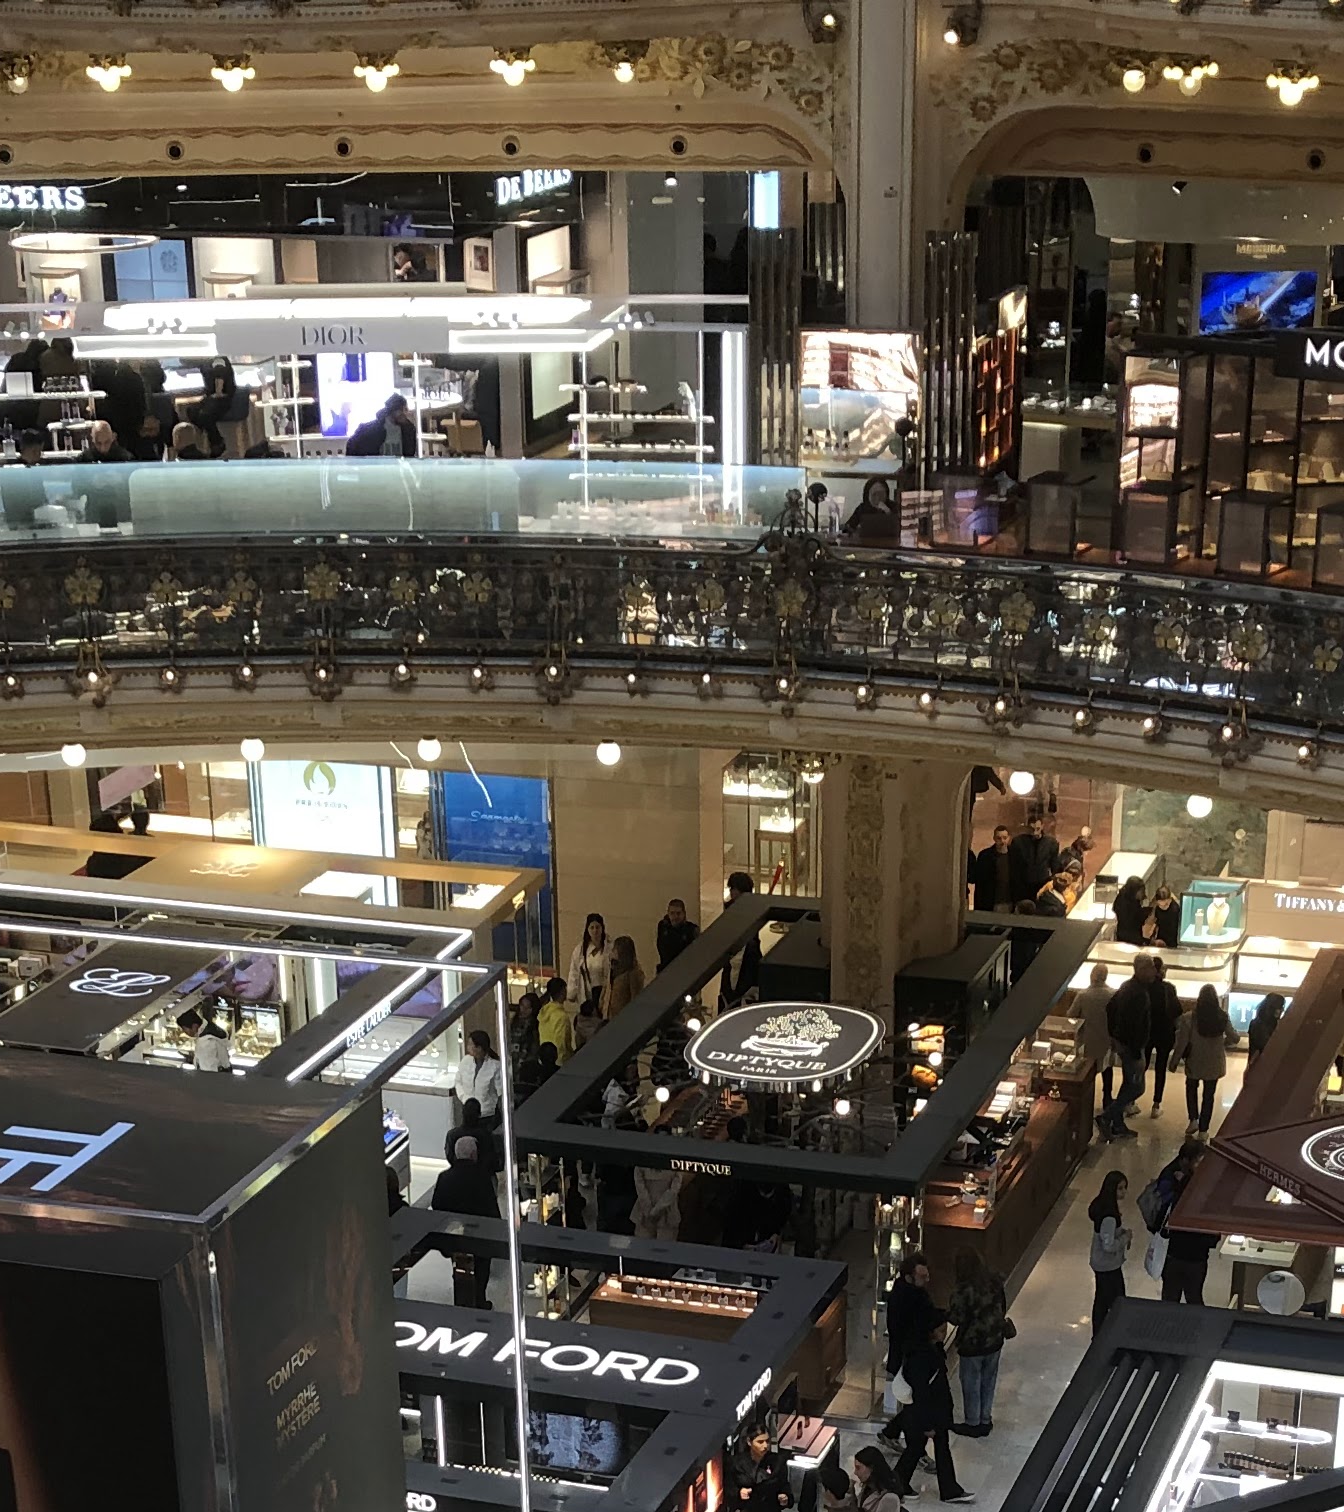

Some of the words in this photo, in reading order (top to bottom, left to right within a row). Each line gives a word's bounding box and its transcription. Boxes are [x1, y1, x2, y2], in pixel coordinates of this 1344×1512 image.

[301, 325, 367, 346] DIOR
[706, 1050, 827, 1071] DIPTYQUE
[670, 1159, 732, 1176] DIPTYQUE
[394, 1320, 489, 1358] OM
[492, 1336, 701, 1386] FORD
[266, 1360, 291, 1396] TOM
[276, 1381, 317, 1431] MYRRHE
[735, 1391, 753, 1422] TOM
[751, 1367, 772, 1402] FORD
[406, 1492, 437, 1512] RD
